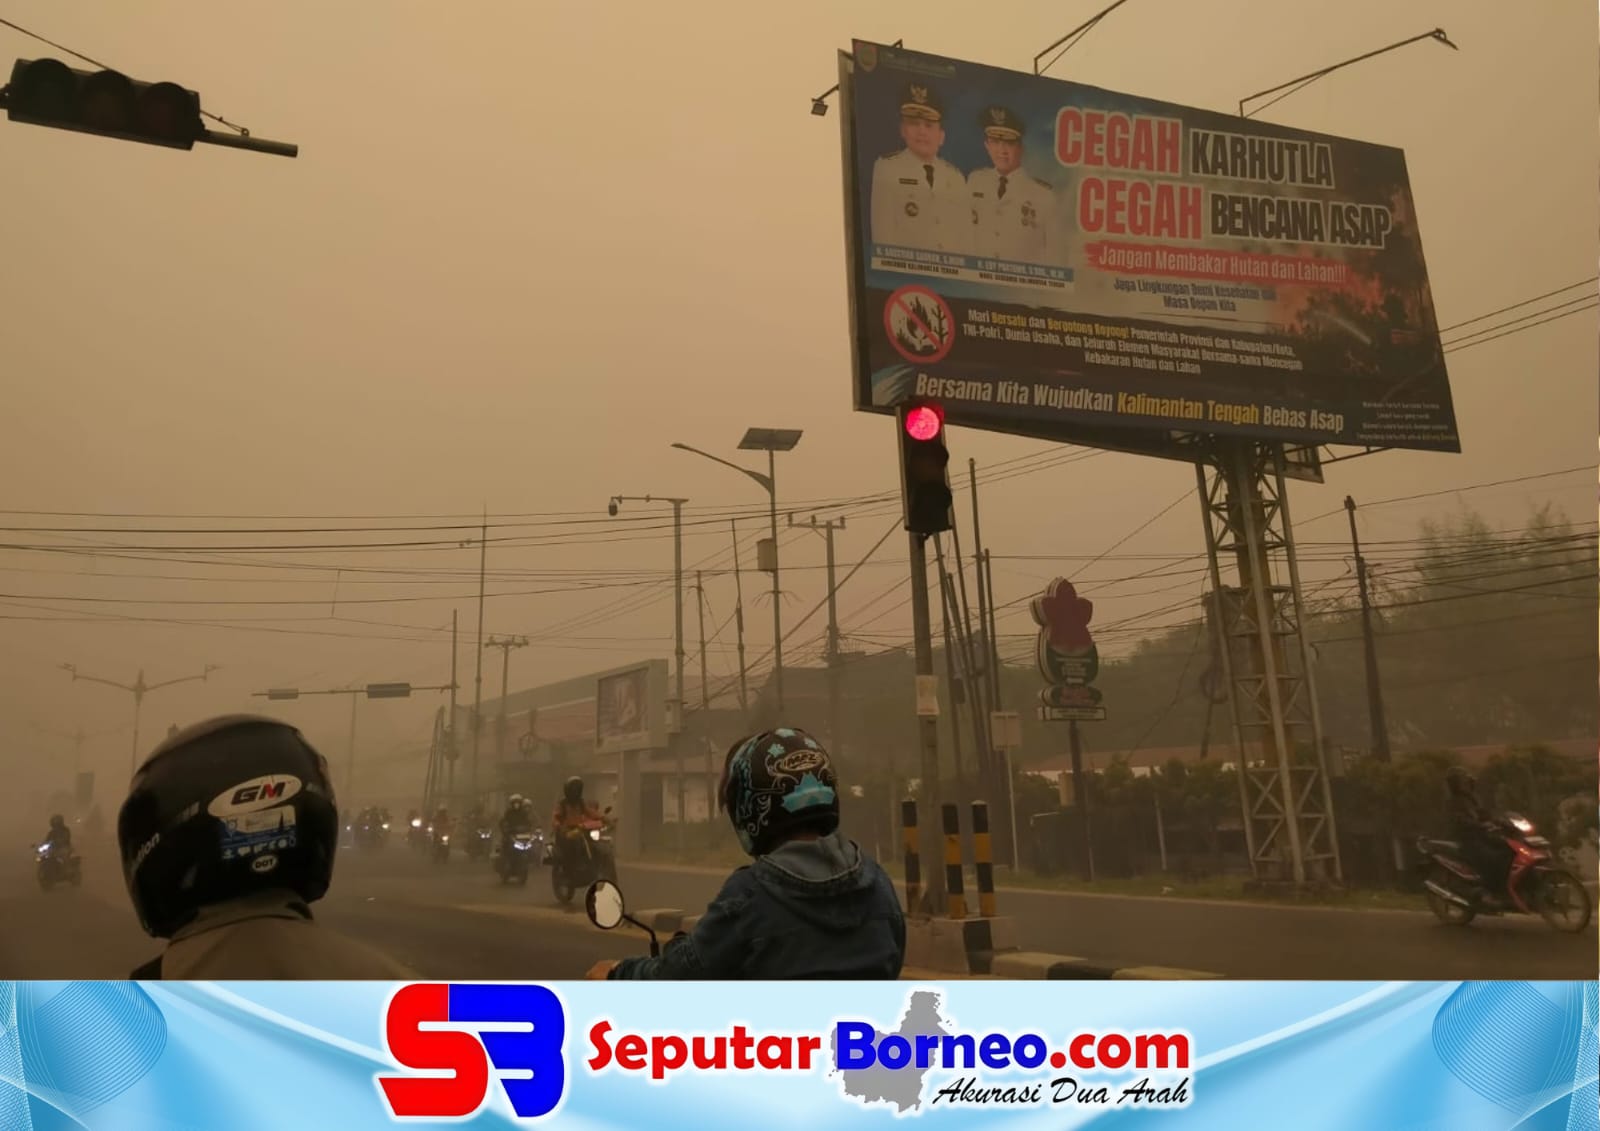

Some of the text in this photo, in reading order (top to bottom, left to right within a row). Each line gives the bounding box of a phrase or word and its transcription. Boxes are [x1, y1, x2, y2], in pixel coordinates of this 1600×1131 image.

[1055, 108, 1332, 187] CEGAH KARHUTLA
[1078, 177, 1390, 248] CEGAH BENCANA ASAP
[1098, 245, 1151, 269] Jangan
[1155, 249, 1228, 274] Membakar
[1230, 256, 1269, 278] Hutan
[1271, 259, 1295, 279] dan
[1162, 295, 1188, 309] Masa
[968, 309, 990, 323] Mari
[992, 312, 1027, 327] Bersatu
[1028, 316, 1046, 329] dan
[1005, 328, 1031, 342] Dunia
[1065, 335, 1082, 348] dan
[1085, 351, 1131, 368] Kebakaran
[1159, 359, 1175, 372] dan
[915, 373, 1344, 434] Bersama Kita Wujudkan Kalimantan Tengah Bebas Asap
[231, 782, 286, 805] GM
[255, 858, 275, 869] DOT
